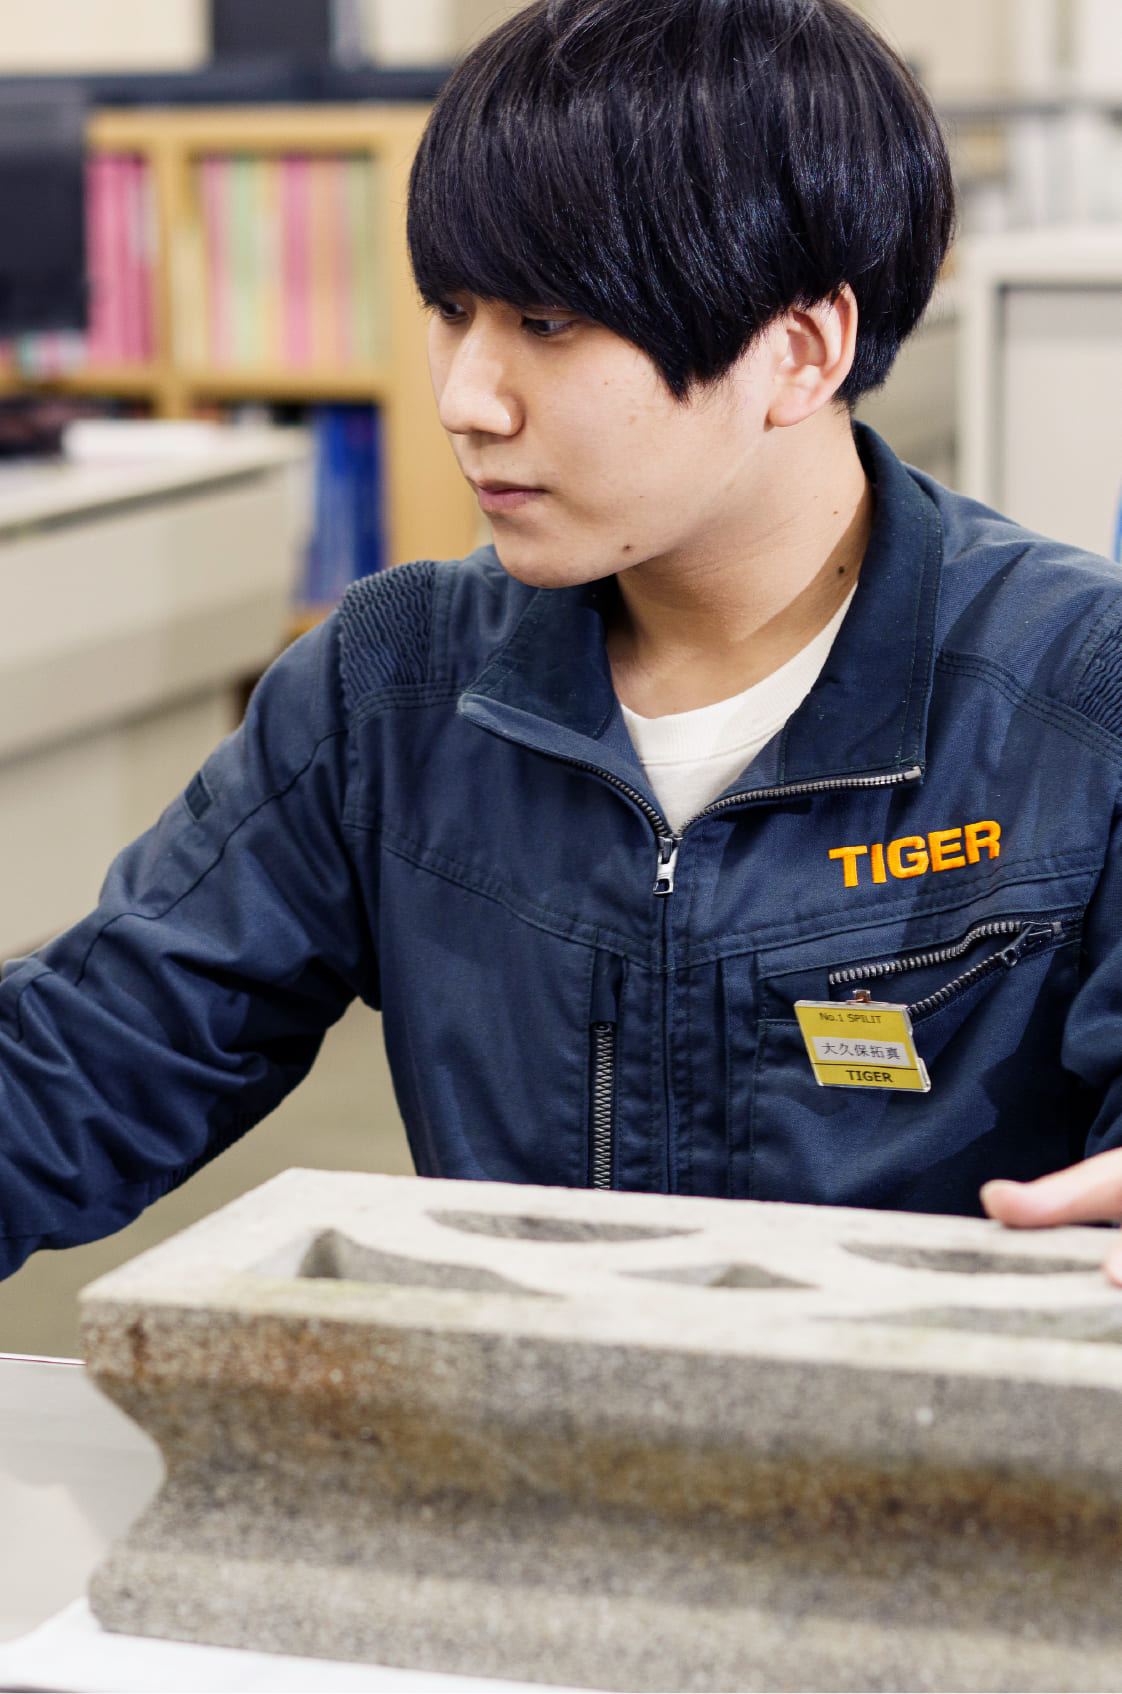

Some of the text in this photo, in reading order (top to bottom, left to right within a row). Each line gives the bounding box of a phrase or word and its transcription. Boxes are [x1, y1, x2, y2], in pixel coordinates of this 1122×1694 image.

[828, 820, 1001, 888] TIGER
[819, 1012, 844, 1023] No.1
[821, 1042, 901, 1060] 大久保拓真
[845, 1070, 894, 1083] TIGER
